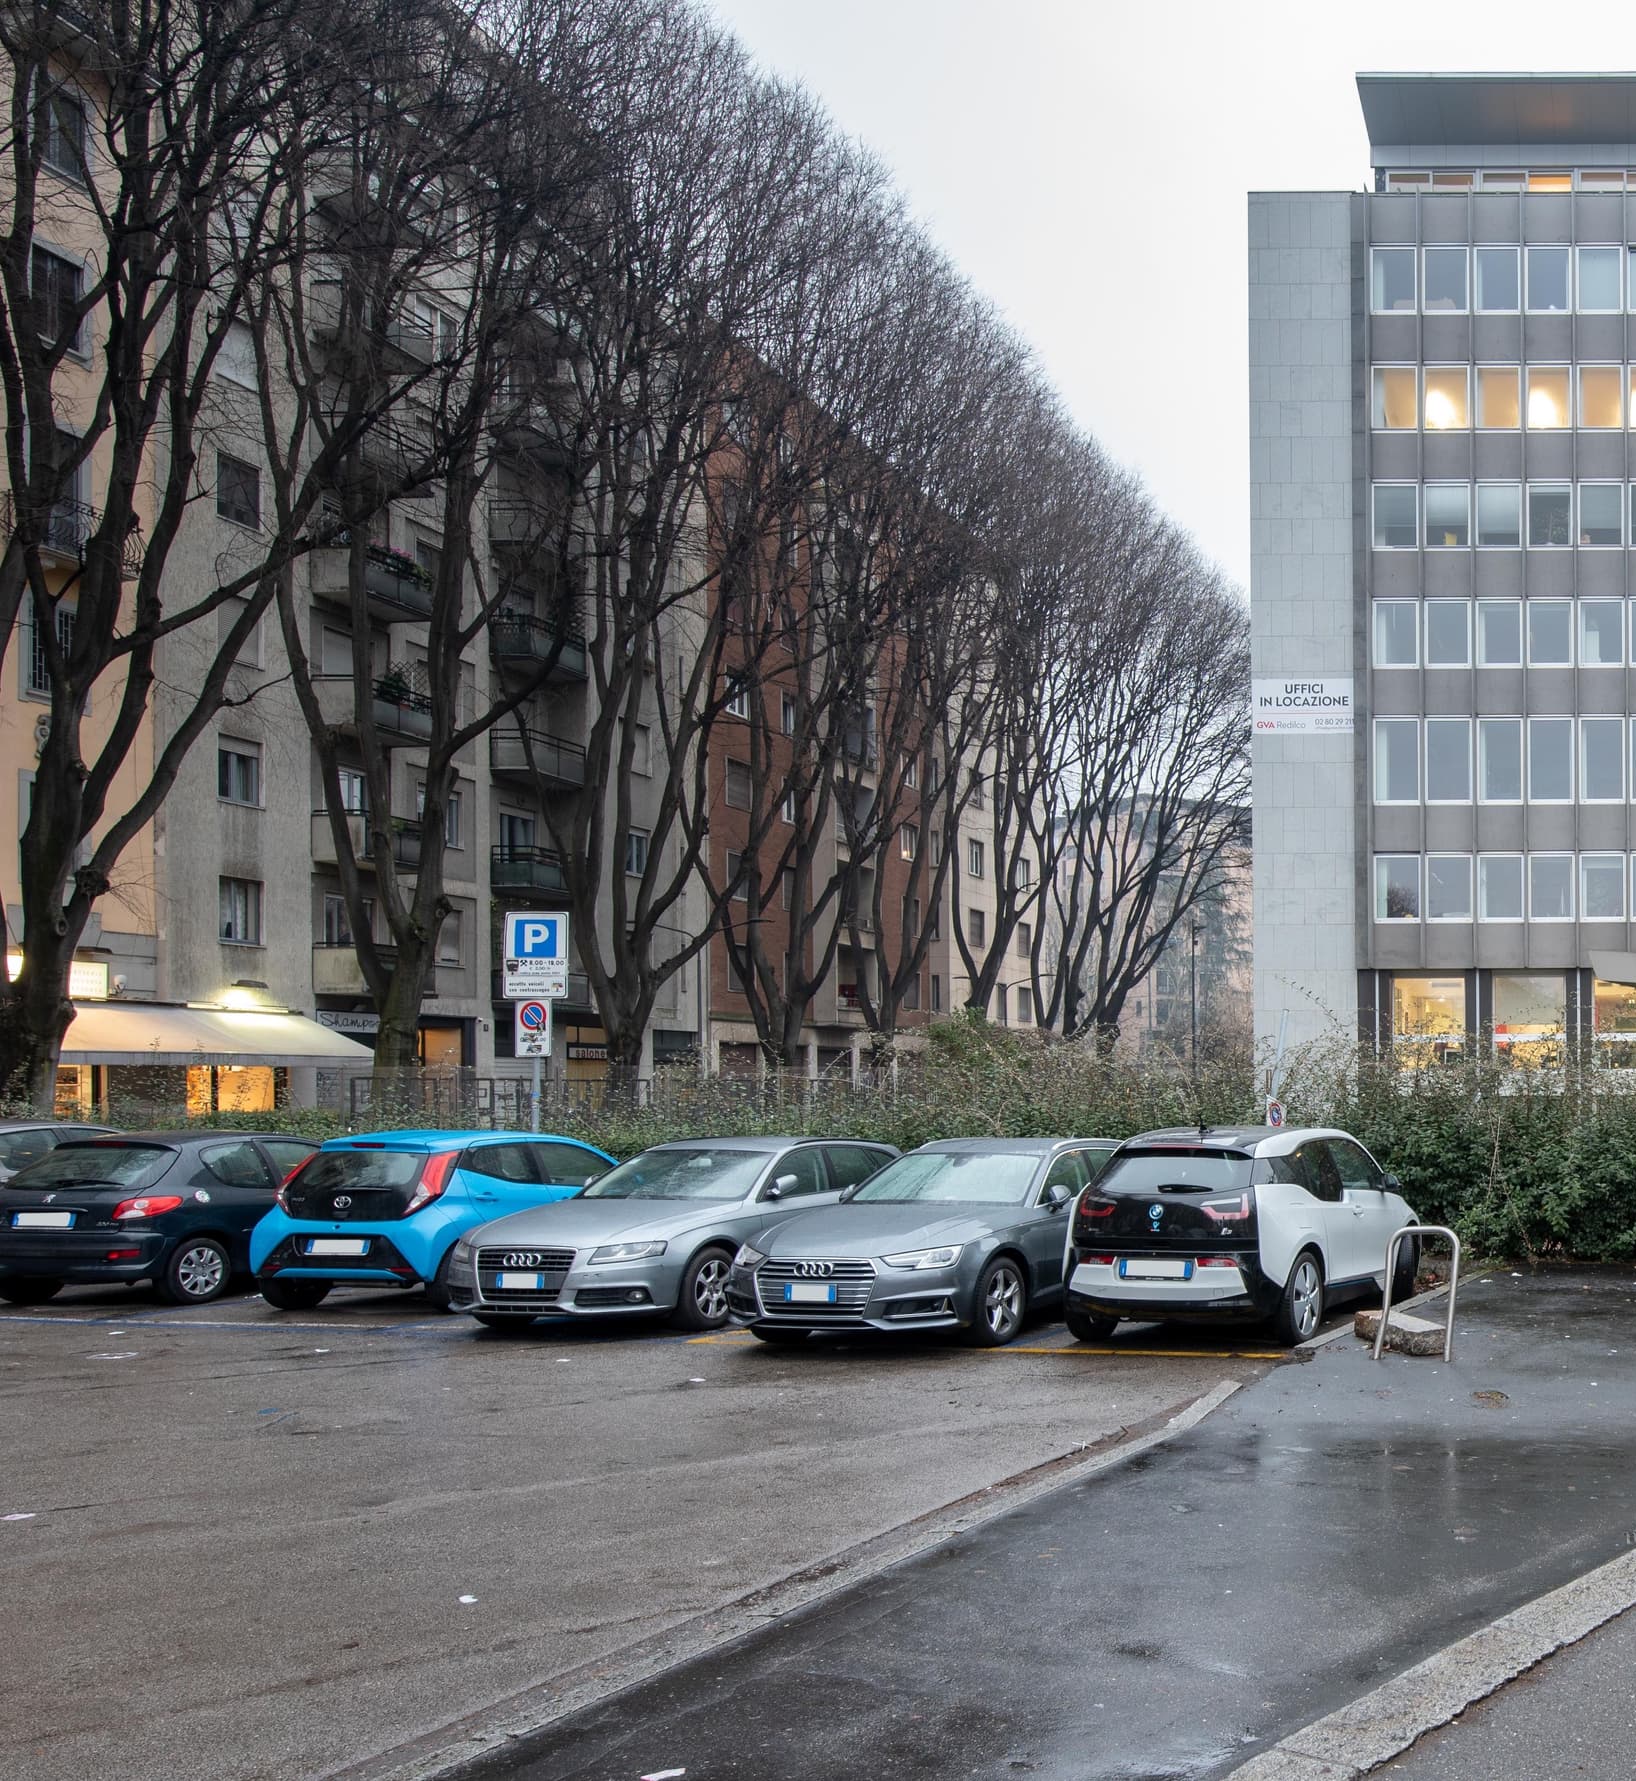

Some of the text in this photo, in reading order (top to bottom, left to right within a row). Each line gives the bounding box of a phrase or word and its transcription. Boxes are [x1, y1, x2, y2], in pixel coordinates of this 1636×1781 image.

[1285, 683, 1323, 694] UFFICI
[1260, 696, 1349, 707] IN LOCAZIONE
[1256, 721, 1275, 729] GVA
[524, 923, 549, 953] P
